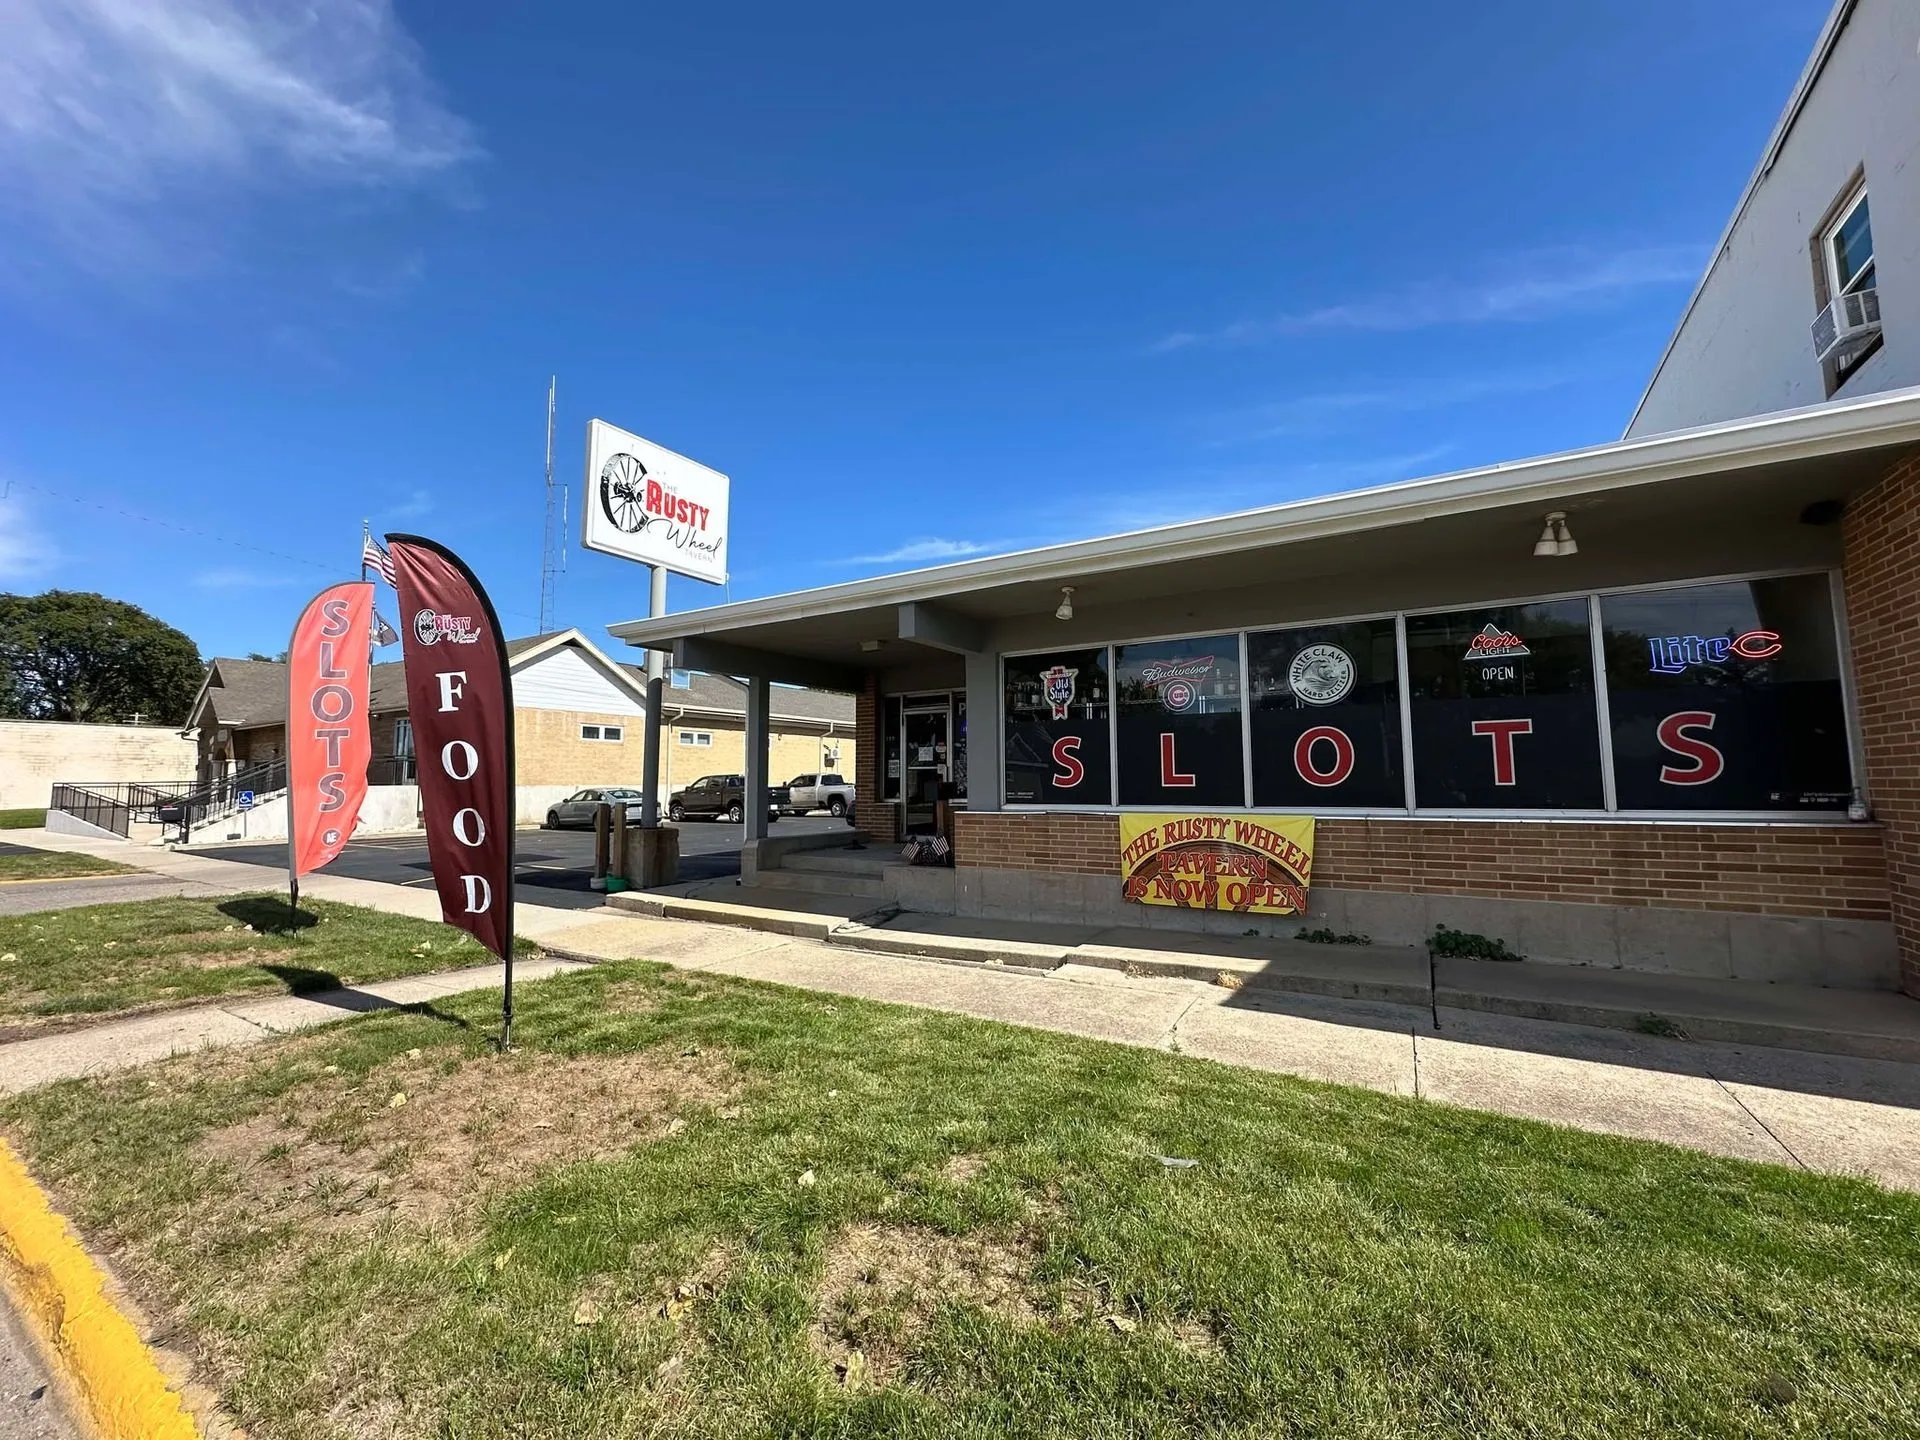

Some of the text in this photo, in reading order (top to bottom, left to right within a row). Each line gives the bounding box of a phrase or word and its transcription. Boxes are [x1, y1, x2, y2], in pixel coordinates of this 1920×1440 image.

[662, 482, 678, 494] THE
[646, 479, 710, 531] RUSTY
[647, 518, 723, 557] Wheel
[434, 616, 471, 631] RUSTY
[1472, 634, 1522, 650] Coors
[1480, 647, 1510, 656] LIGHT
[1648, 635, 1731, 674] Lite
[1142, 665, 1213, 681] Budweiser
[1292, 648, 1346, 684] WHITE CLAW
[1482, 666, 1514, 681] OPEN
[1050, 687, 1070, 700] Style
[1055, 679, 1069, 690] Old
[1302, 670, 1347, 698] HARD SELTZER
[311, 600, 354, 813] SLOTS
[435, 671, 492, 915] FOOD
[1121, 817, 1310, 880] THE RUSTY WHEEL
[1156, 852, 1269, 879] TAVERN
[1125, 875, 1309, 910] IS NOW OPEN
